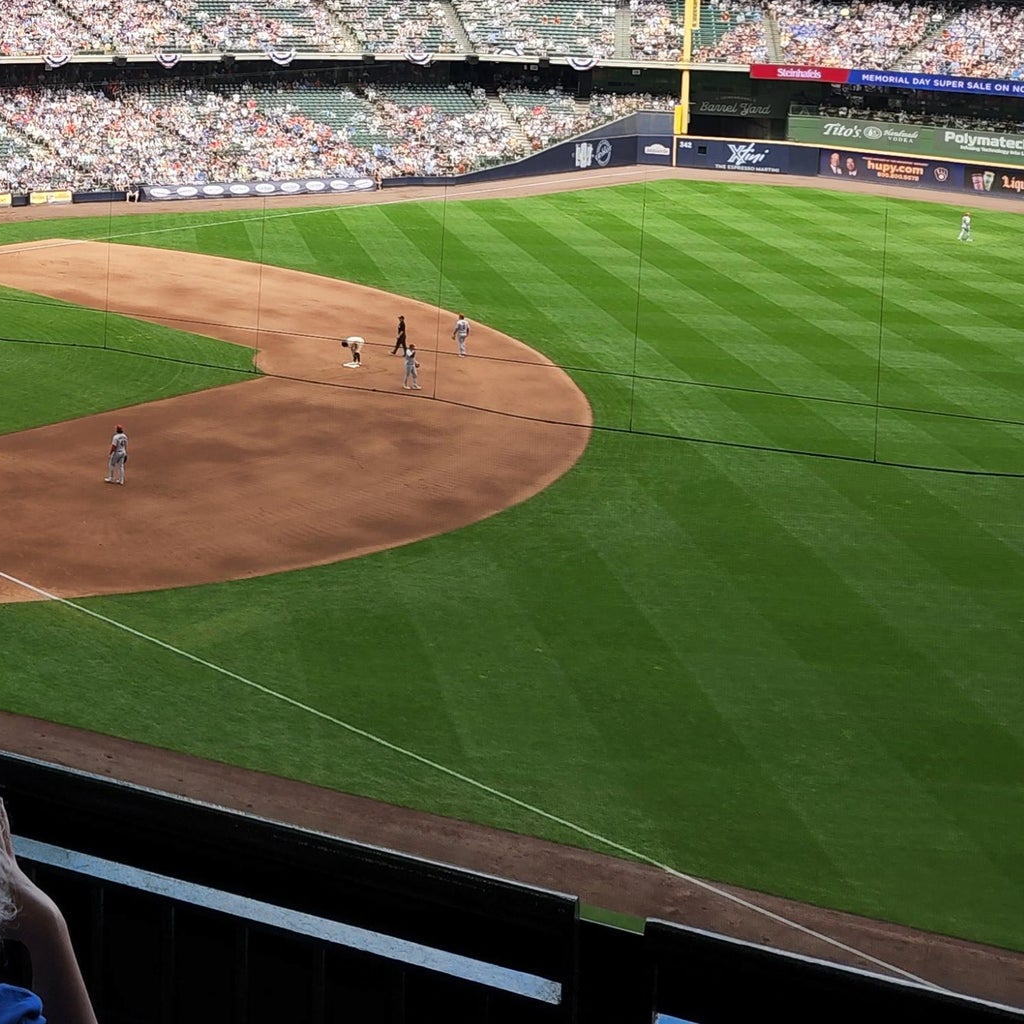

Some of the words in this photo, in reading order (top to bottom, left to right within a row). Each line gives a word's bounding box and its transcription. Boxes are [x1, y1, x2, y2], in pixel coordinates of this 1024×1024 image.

[777, 67, 822, 79] Steinhafels
[862, 73, 910, 85] MEMORIAL
[912, 77, 930, 86] DAY
[933, 79, 964, 89] SUPER
[967, 82, 991, 91] SALE
[994, 84, 1009, 92] ON
[700, 101, 737, 113] Barrel
[739, 102, 771, 116] Yard
[823, 122, 860, 138] Tito's
[679, 141, 692, 149] 342
[888, 136, 914, 144] VODKA
[867, 159, 924, 176] hupy.com
